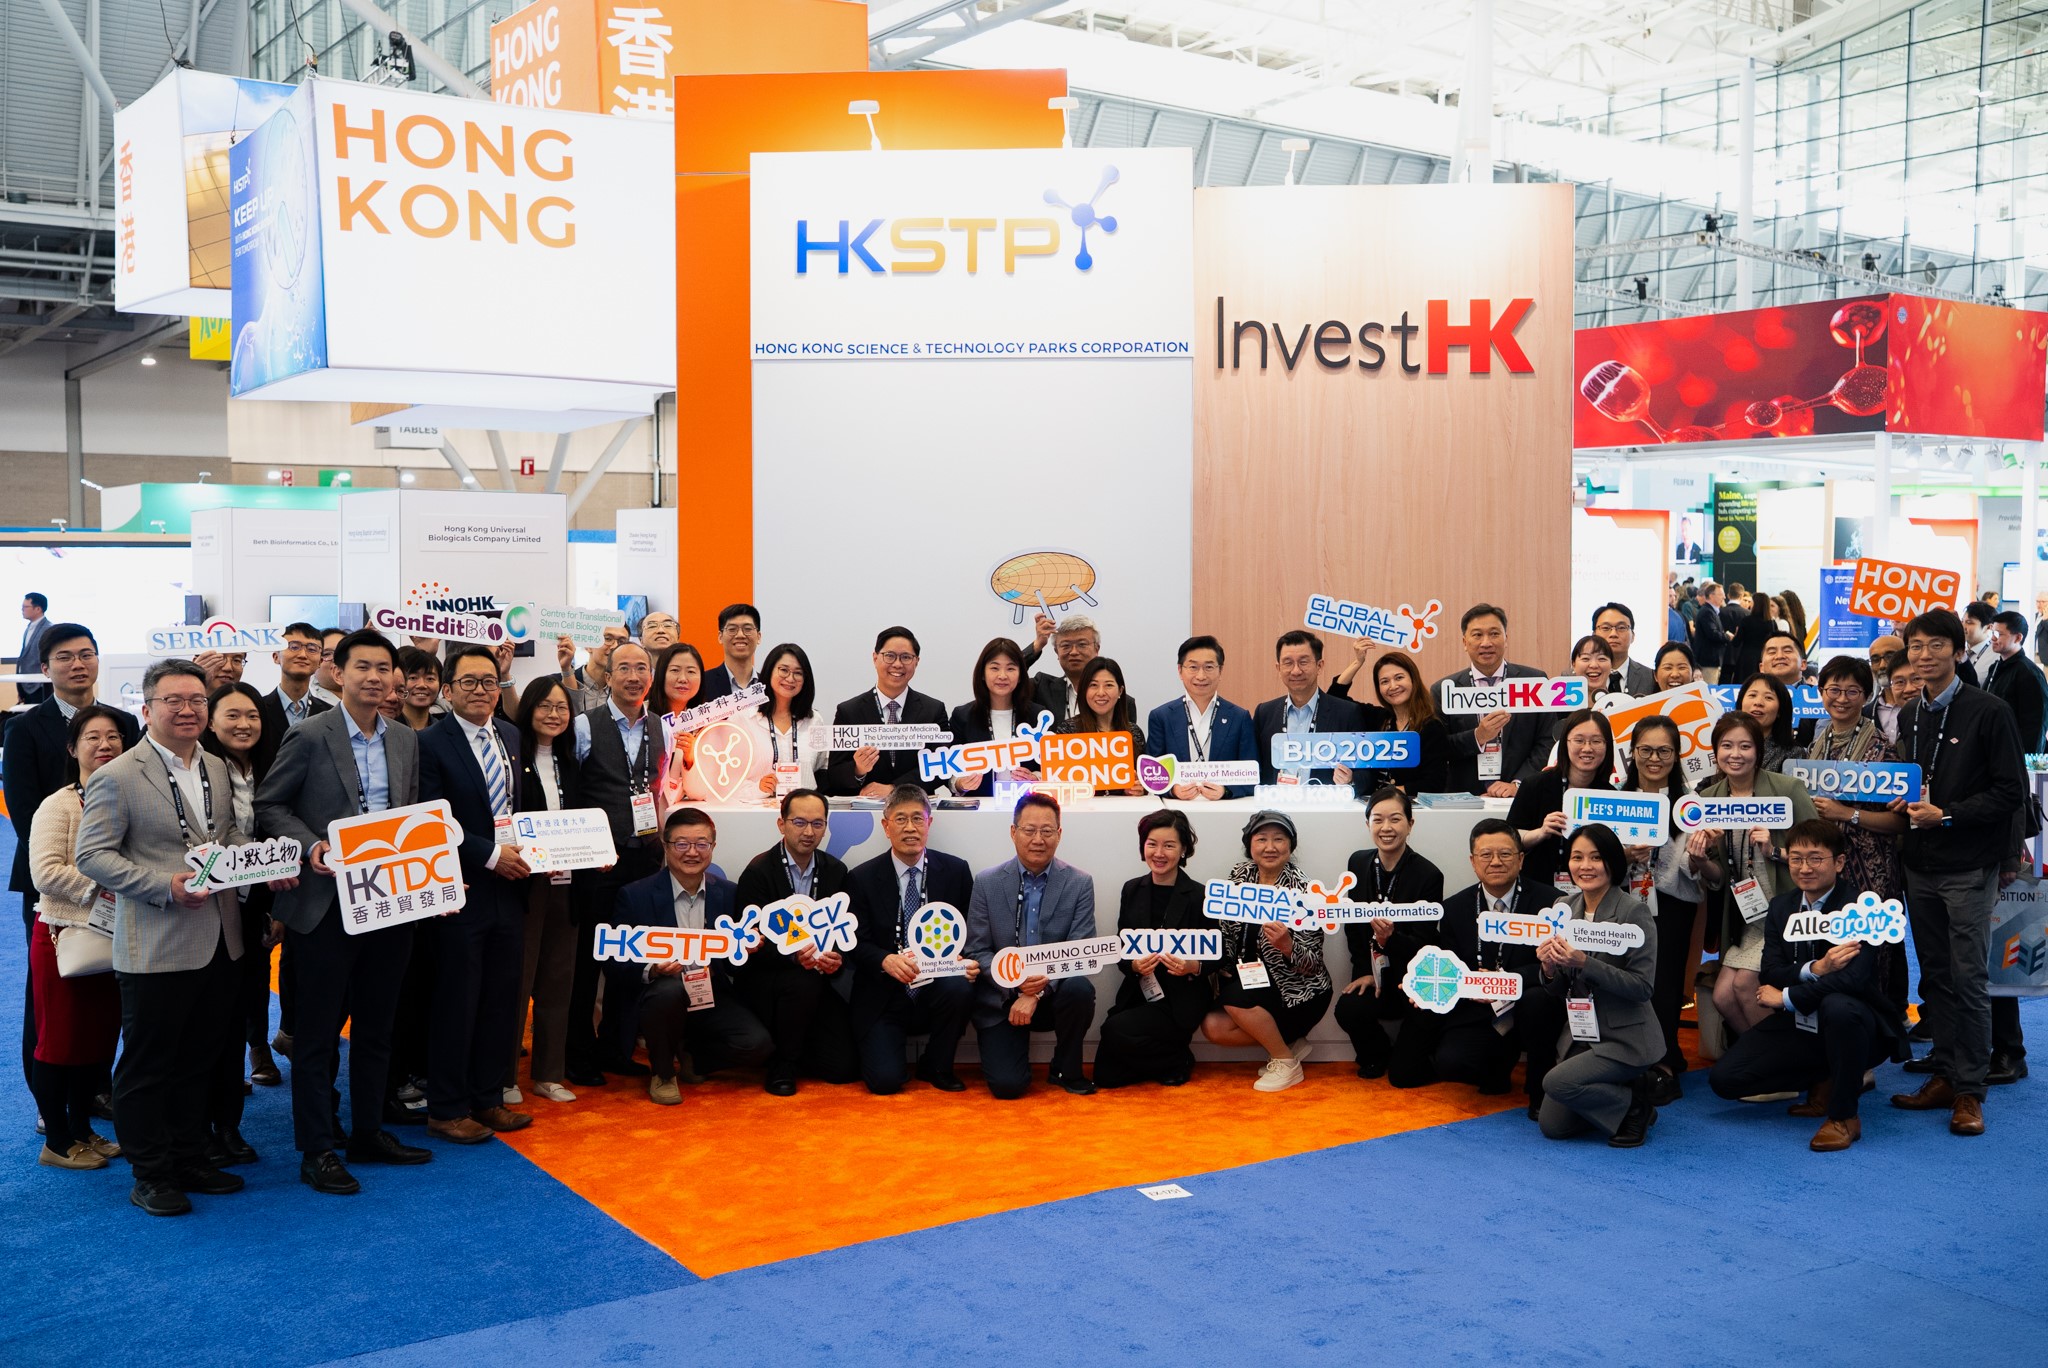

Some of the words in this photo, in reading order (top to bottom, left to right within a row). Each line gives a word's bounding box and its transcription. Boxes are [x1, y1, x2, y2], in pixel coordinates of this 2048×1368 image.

[495, 6, 560, 80] HONG
[332, 103, 574, 182] HONG
[119, 139, 136, 275] 香港
[234, 196, 259, 228] KEEP
[260, 186, 273, 212] UP
[337, 176, 576, 249] KONG
[796, 217, 1061, 274] HKSTP
[1216, 295, 1536, 377] InvestHK
[755, 343, 798, 355] HONG
[802, 342, 844, 354] KONG
[847, 343, 909, 355] SCIENCE
[913, 343, 923, 355] &
[926, 343, 1025, 355] TECHNOLOGY
[1029, 342, 1078, 354] PARKS
[1081, 341, 1189, 354] CORPORATION
[428, 534, 472, 543] Biologicals
[473, 535, 511, 544] Company
[512, 535, 541, 543] Limited
[444, 526, 466, 534] Hong
[468, 526, 489, 535] Kong
[491, 526, 526, 534] Universal
[1859, 562, 1956, 597] HONG
[540, 608, 566, 618] Centre
[567, 610, 578, 619] for
[579, 611, 622, 623] Translational
[1310, 597, 1396, 628] GLOBAL
[539, 619, 560, 628] Stem
[561, 620, 575, 629] Cell
[576, 621, 602, 634] Biology
[1307, 612, 1409, 645] CONNECT
[679, 684, 765, 723] 創新科技署
[1446, 682, 1544, 709] InvestHK
[1551, 681, 1584, 707] 25
[707, 710, 735, 723] Technology
[736, 698, 768, 712] Commission
[833, 727, 860, 738] HKU
[879, 726, 902, 734] Faculty
[833, 738, 860, 749] Med
[1045, 736, 1129, 762] HONG
[922, 741, 1034, 778] HKSTP
[1046, 764, 1132, 786] KONG
[1144, 766, 1162, 776] CU
[1180, 771, 1208, 779] Faculty
[1222, 769, 1258, 777] Medicine
[1588, 803, 1614, 816] LEE'S
[1617, 804, 1655, 819] PHARM.
[1704, 803, 1786, 816] ZHAOKE
[1705, 816, 1786, 824] OPHTHALMOLOGY
[226, 841, 298, 872] 小默生物
[229, 865, 297, 883] xiaomobio.com
[345, 849, 455, 905] HKTDC
[1208, 883, 1293, 905] GLOBA
[352, 885, 458, 925] 香港貿發局
[1318, 907, 1351, 919] BETH
[1354, 905, 1439, 918] Bioinformatics
[1485, 919, 1551, 938] HKSTP
[1573, 927, 1588, 936] Life
[1590, 929, 1606, 937] and
[1609, 931, 1637, 940] Health
[1791, 914, 1888, 940] Allegrow
[597, 928, 729, 961] HKSTP
[1126, 934, 1217, 955] XUXIN
[1573, 935, 1622, 947] Technology
[1026, 947, 1080, 963] IMMUNO
[1083, 942, 1116, 955] CURE
[1046, 959, 1097, 975] 医克生物
[1464, 976, 1517, 988] DECODE
[1482, 985, 1517, 996] CURE
